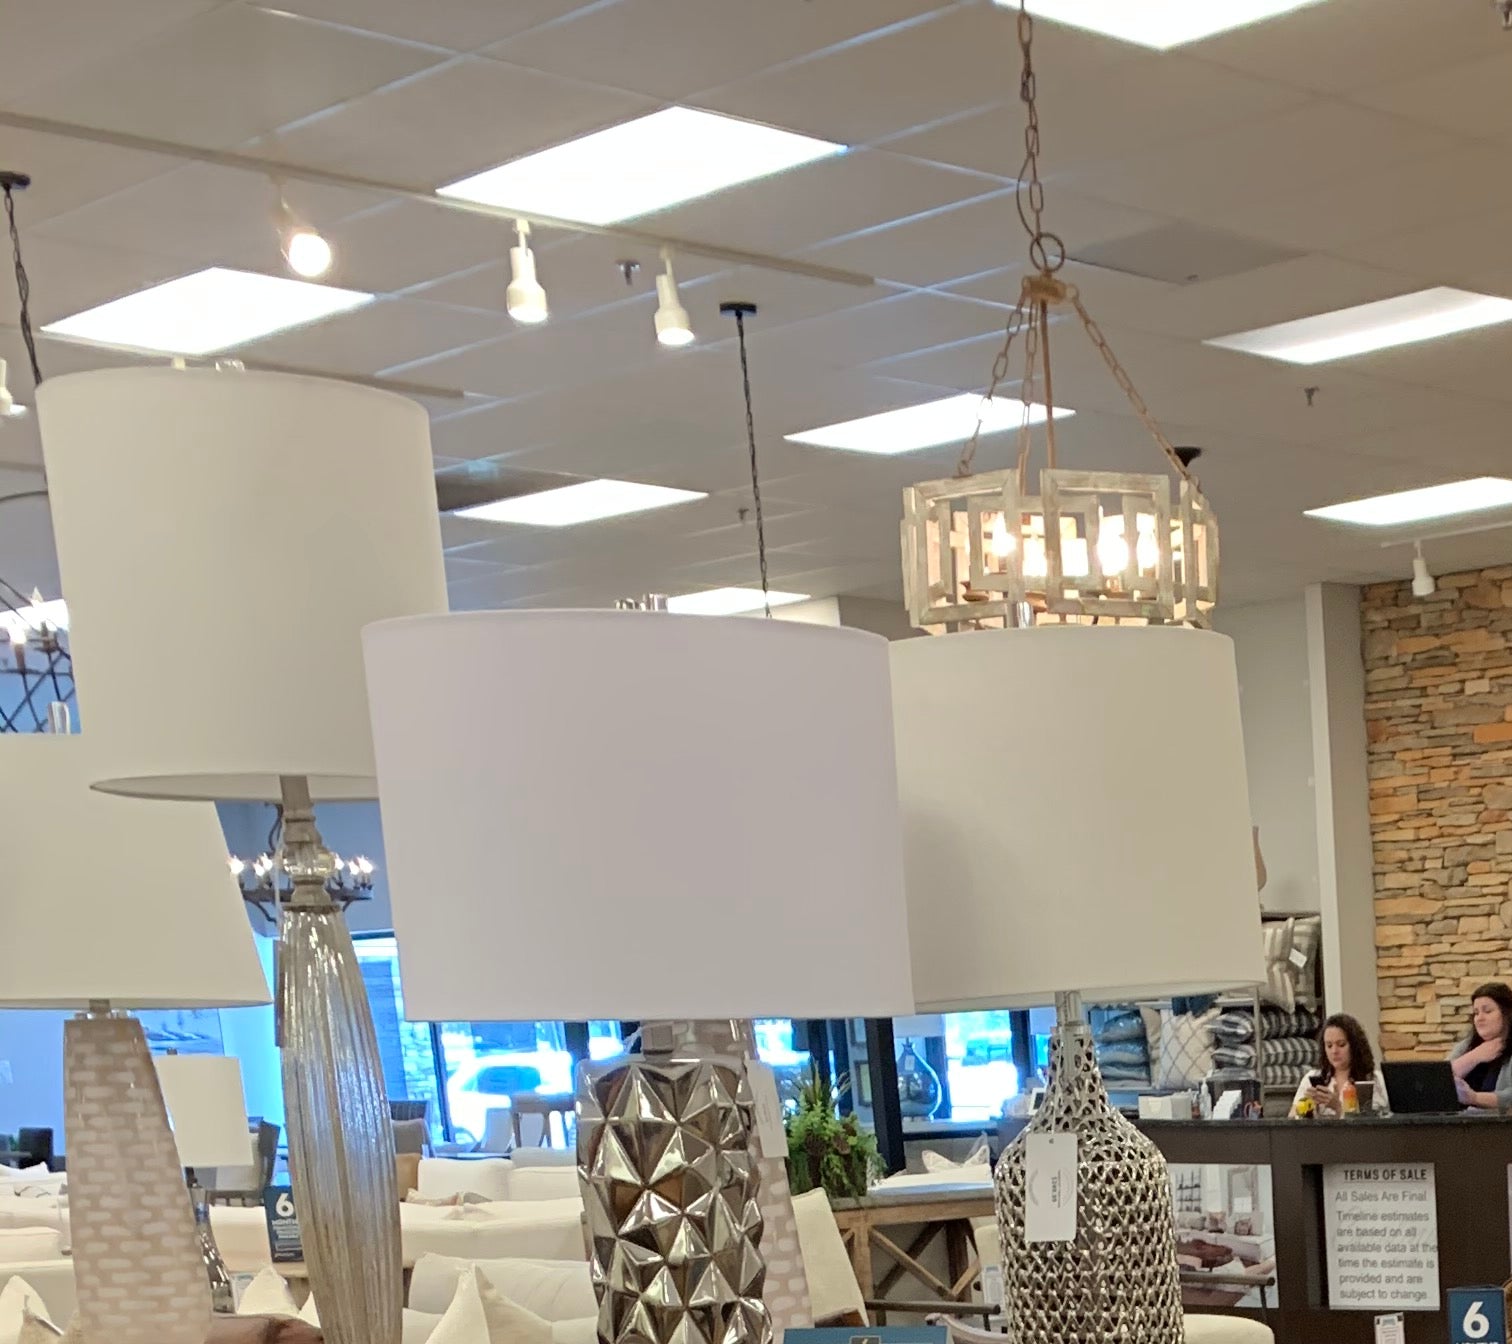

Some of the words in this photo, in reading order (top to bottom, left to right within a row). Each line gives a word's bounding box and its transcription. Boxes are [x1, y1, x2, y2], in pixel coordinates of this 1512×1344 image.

[1344, 1169, 1379, 1181] TERMS
[1382, 1169, 1396, 1180] OF
[1400, 1169, 1427, 1180] SALE
[1335, 1191, 1348, 1201] All
[1351, 1190, 1379, 1201] Sales
[1381, 1191, 1399, 1201] Are
[1402, 1190, 1427, 1201] Final
[276, 1193, 294, 1217] 6
[1336, 1210, 1378, 1221] Timeline
[1381, 1211, 1429, 1221] estimates
[1337, 1229, 1353, 1237] are
[1355, 1227, 1387, 1237] based
[1389, 1228, 1401, 1237] on
[1405, 1227, 1417, 1237] all
[1337, 1243, 1381, 1252] available
[1384, 1243, 1407, 1253] data
[1410, 1243, 1419, 1253] at
[1422, 1243, 1438, 1252] the
[1338, 1258, 1359, 1268] time
[1362, 1258, 1377, 1268] the
[1381, 1259, 1423, 1268] estimate
[1426, 1259, 1434, 1269] is
[1340, 1274, 1382, 1285] provided
[1385, 1274, 1403, 1284] and
[1406, 1275, 1423, 1284] are
[1340, 1289, 1375, 1301] subject
[1378, 1289, 1388, 1299] to
[1390, 1290, 1427, 1302] change
[1463, 1301, 1489, 1338] 6
